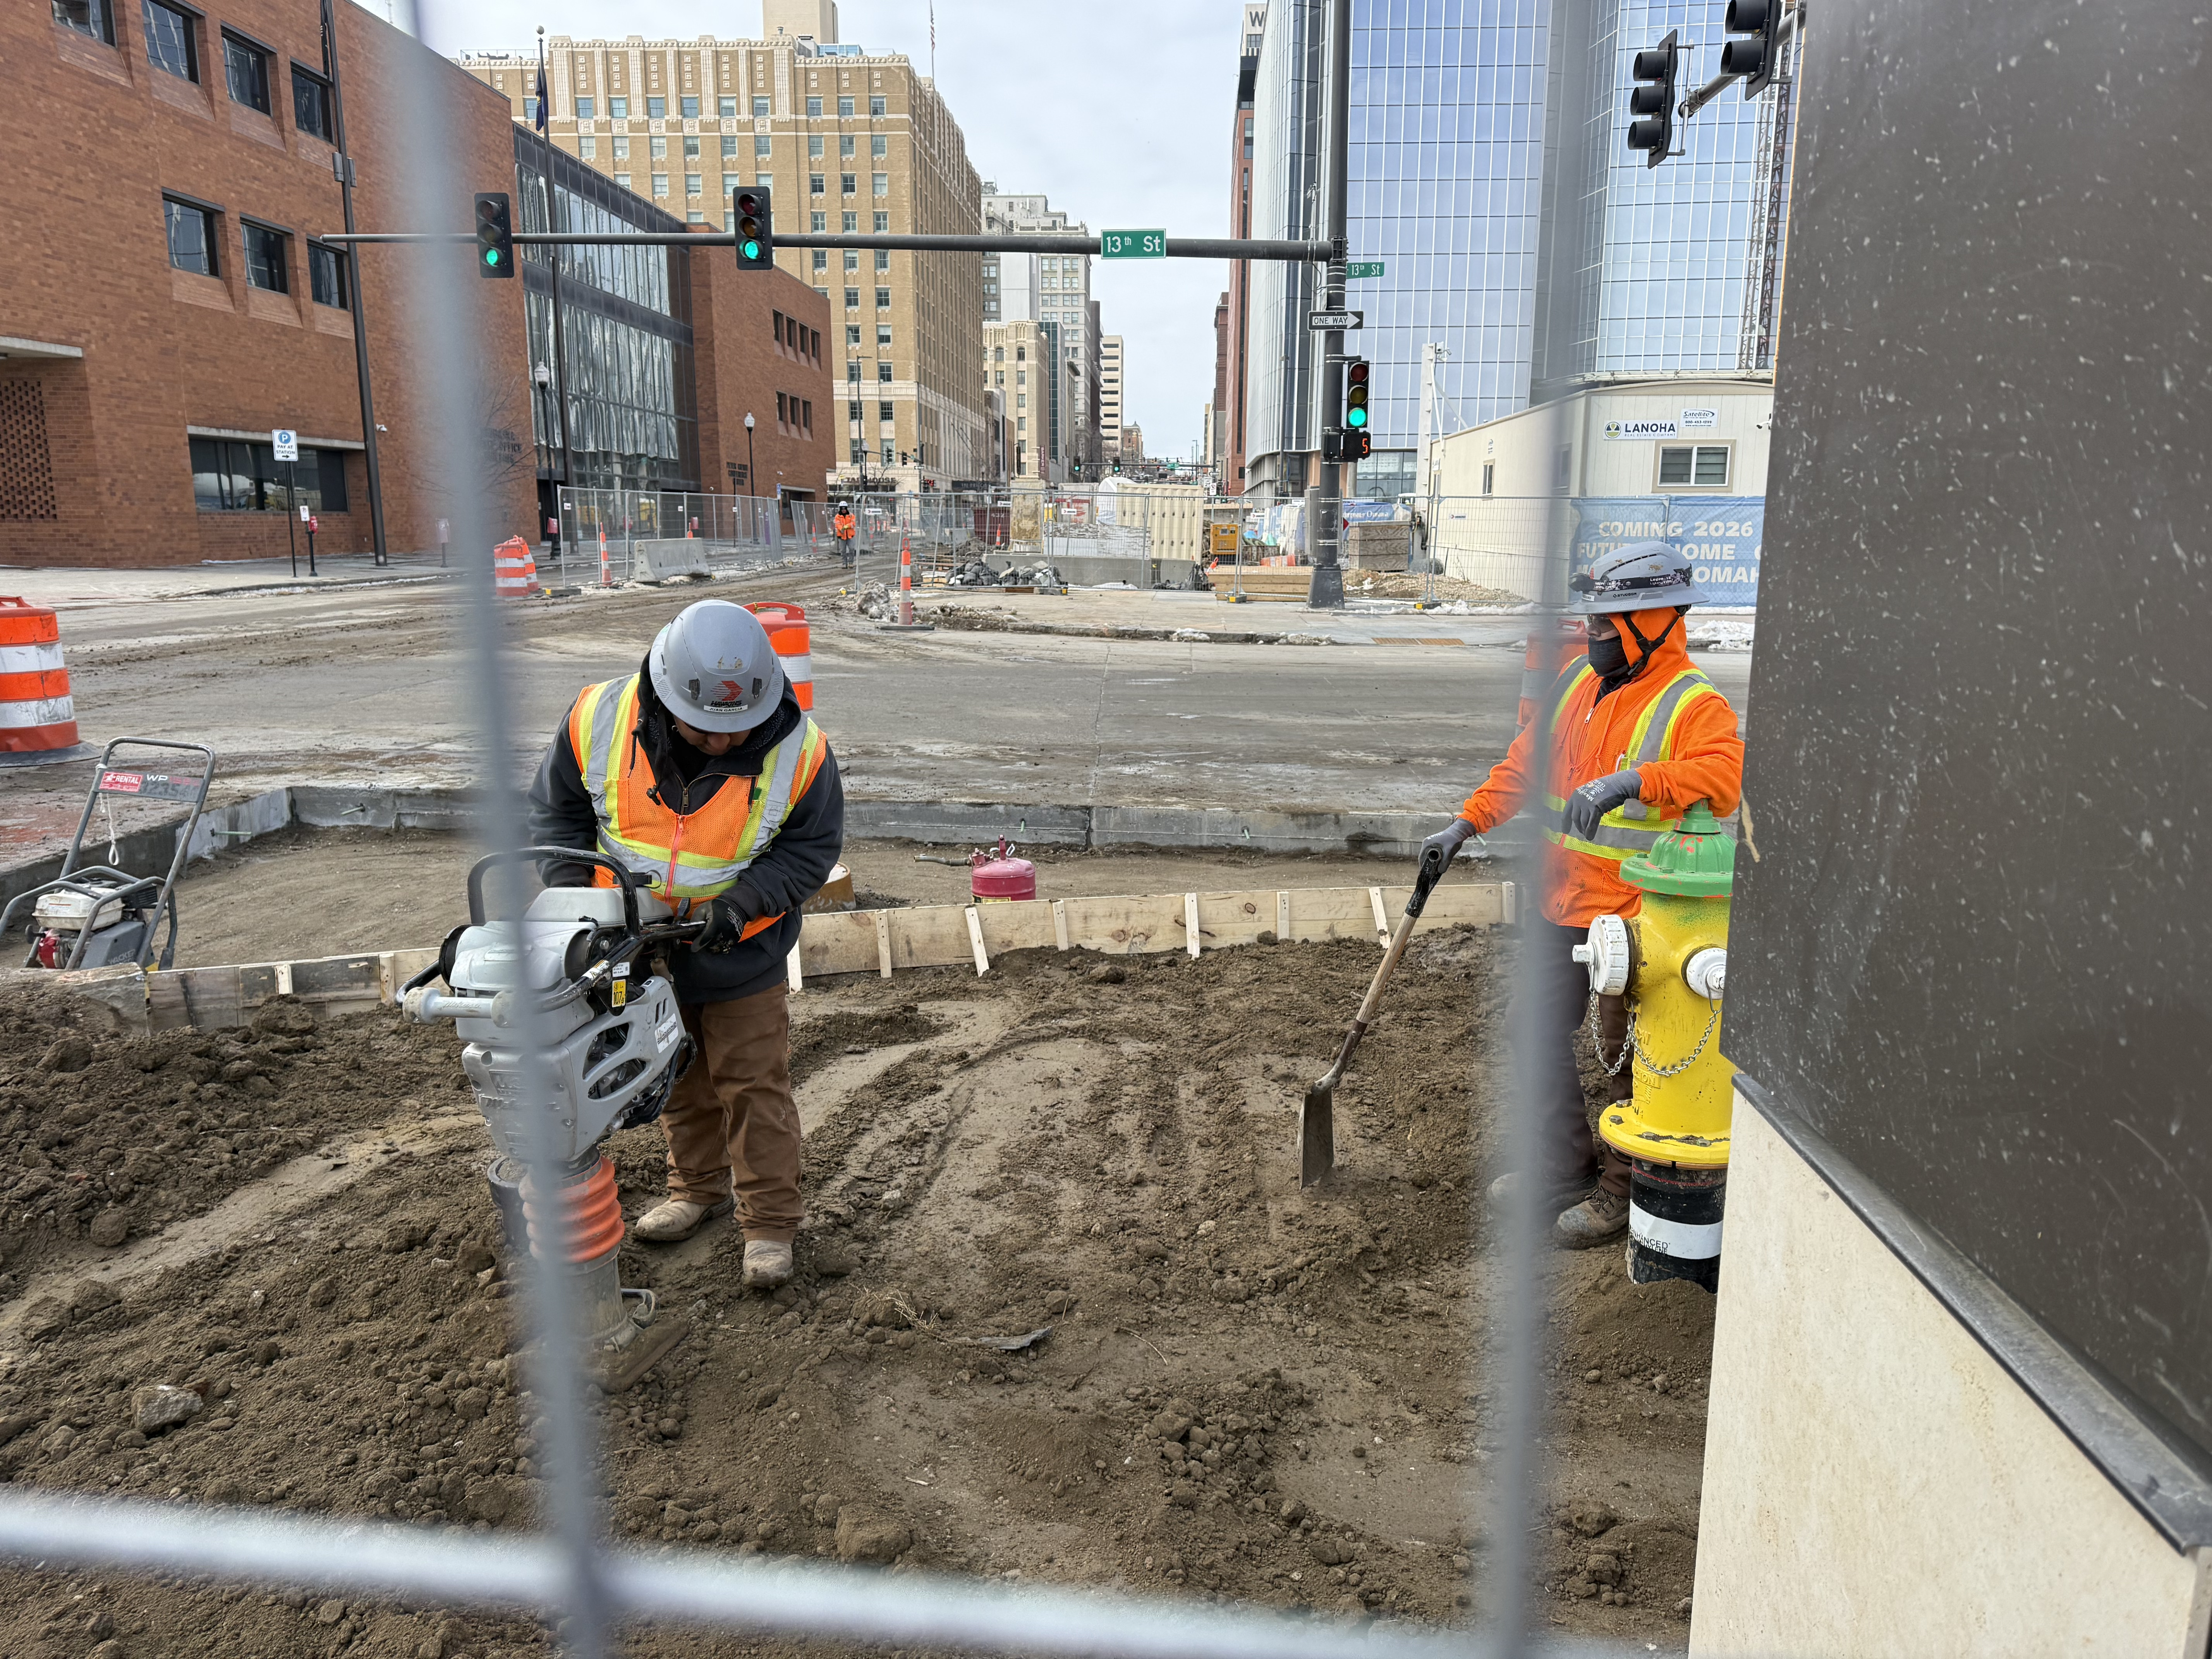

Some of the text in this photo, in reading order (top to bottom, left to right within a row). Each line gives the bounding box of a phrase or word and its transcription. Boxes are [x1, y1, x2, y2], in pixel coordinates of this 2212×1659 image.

[1106, 235, 1161, 252] 13th St
[1352, 264, 1380, 275] 13th St
[1625, 423, 1676, 433] LANOHA
[1362, 438, 1368, 453] 5
[1599, 521, 1753, 537] COMING 2026
[115, 775, 139, 784] RENTAL
[613, 991, 622, 1005] 107
